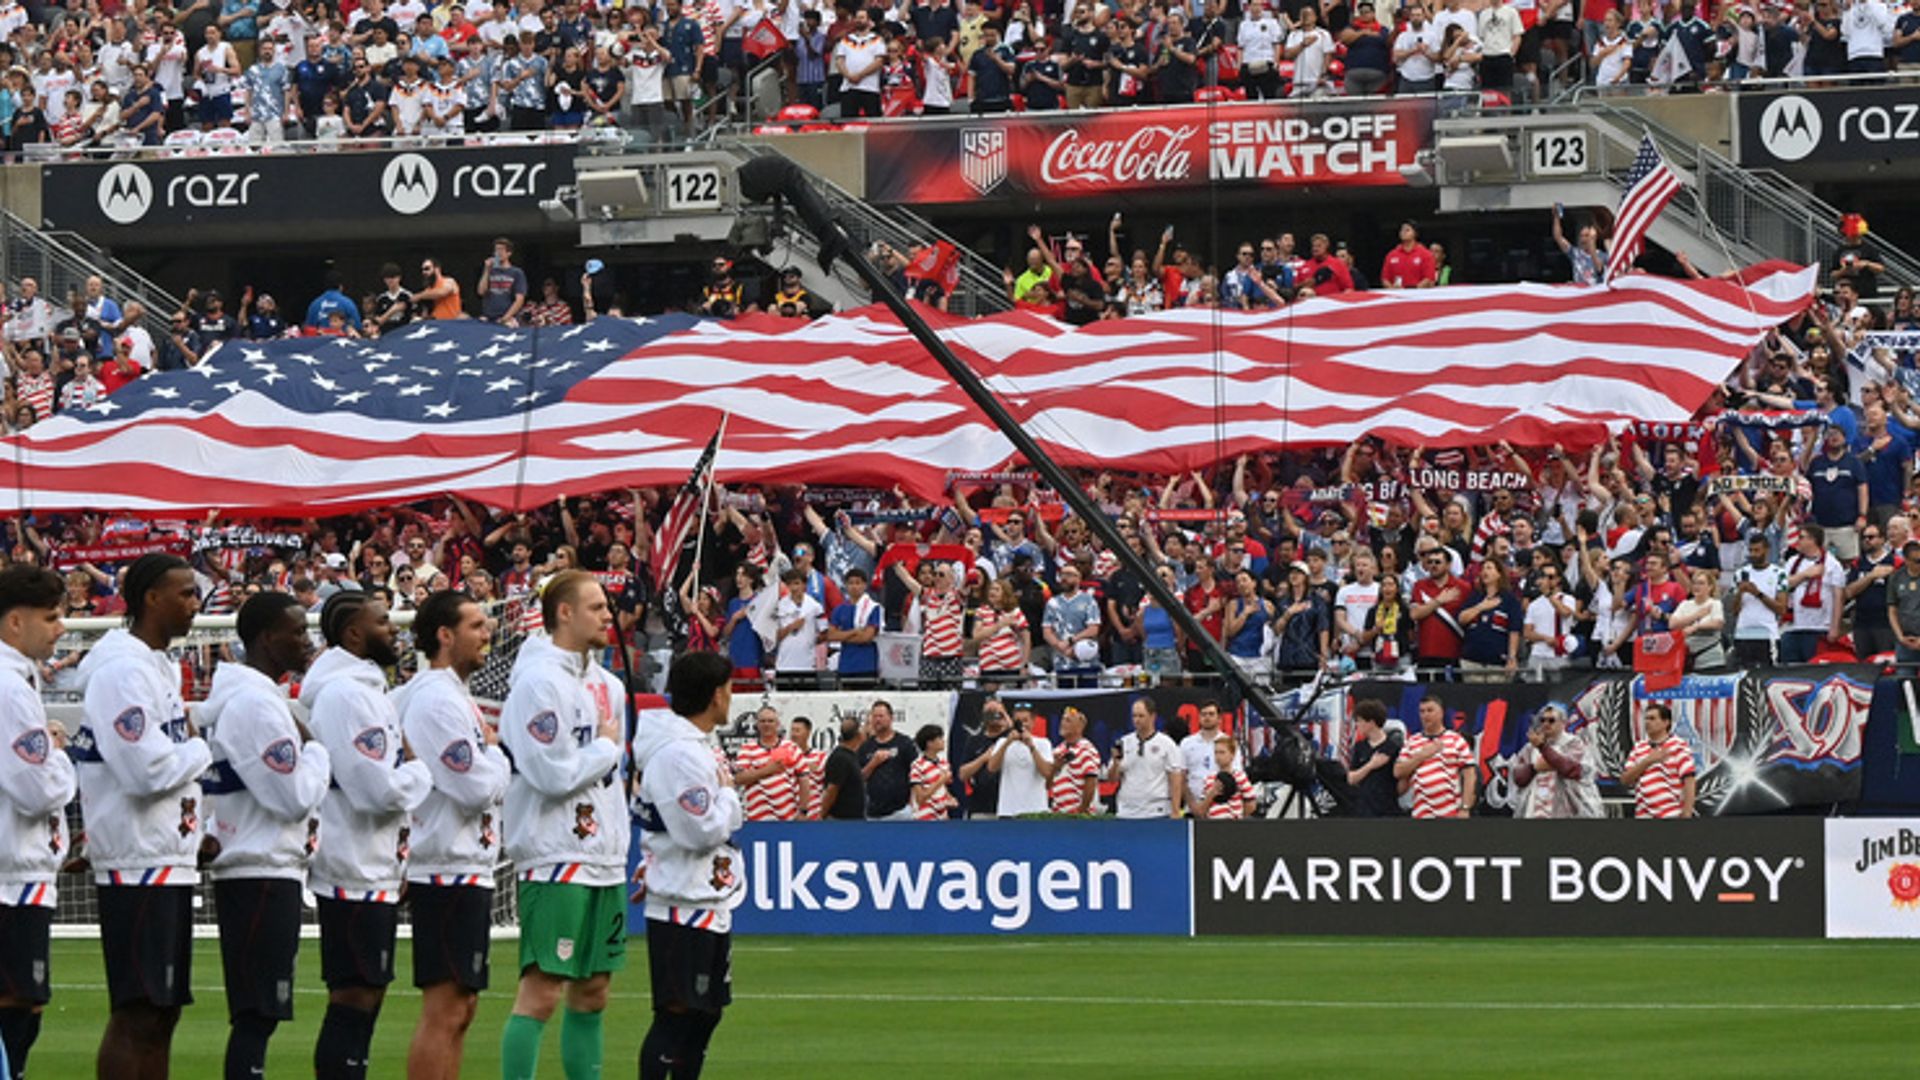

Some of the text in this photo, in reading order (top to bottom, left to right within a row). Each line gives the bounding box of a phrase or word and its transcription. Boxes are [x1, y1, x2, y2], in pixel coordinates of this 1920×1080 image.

[1209, 114, 1397, 145] SEND-OFF
[1839, 104, 1919, 142] raz
[964, 131, 1002, 156] USA
[1041, 124, 1198, 184] Coca-Cola
[1209, 140, 1397, 180] MATCH
[1535, 137, 1584, 168] 123
[167, 173, 260, 207] razr
[453, 162, 547, 197] razr
[670, 172, 717, 202] 122
[1411, 469, 1527, 490] LONG BEACH
[1855, 837, 1895, 872] JIM
[738, 841, 1132, 929] lkswagen
[1212, 857, 1523, 901] MARRIOTT
[605, 911, 626, 945] 2
